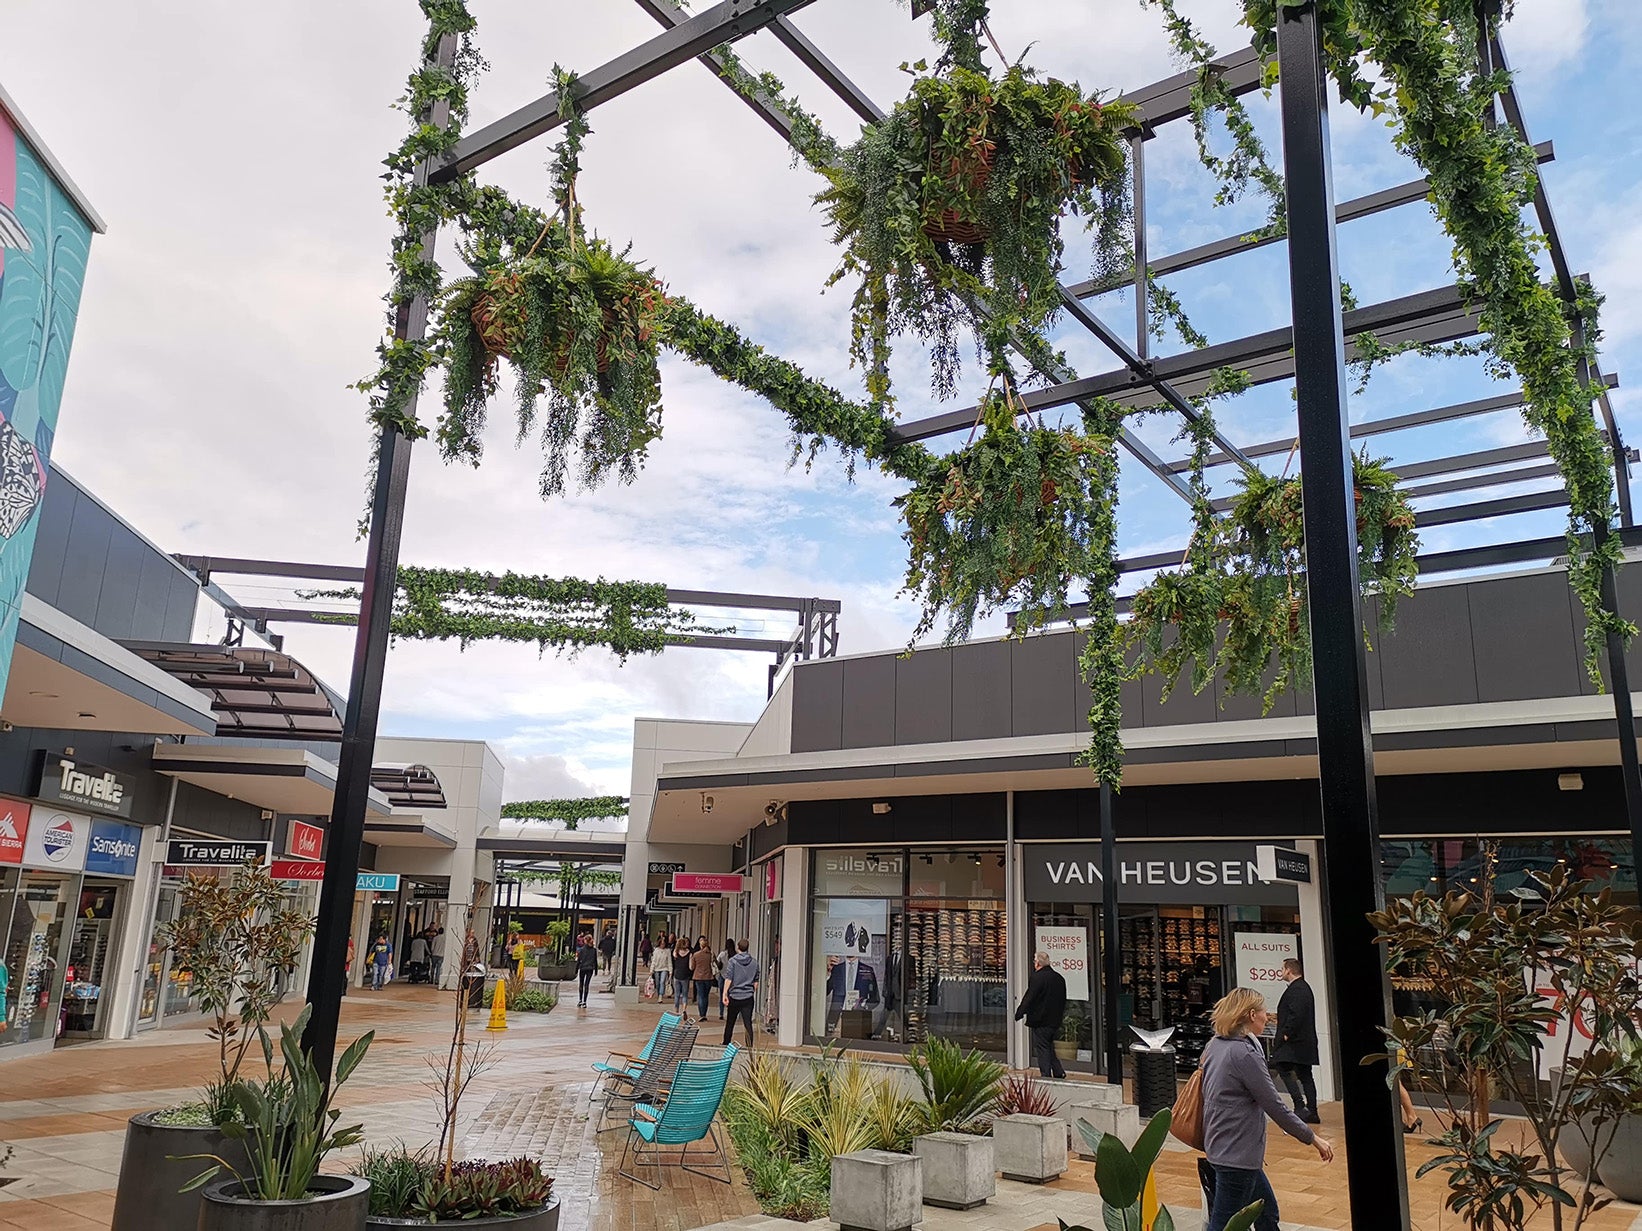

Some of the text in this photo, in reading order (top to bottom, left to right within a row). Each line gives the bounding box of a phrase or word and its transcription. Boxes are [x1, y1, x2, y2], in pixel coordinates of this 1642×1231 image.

[45, 829, 73, 840] AMERICAN
[1, 839, 22, 848] SIERRA
[44, 836, 72, 846] TOURISTER
[92, 836, 136, 857] Samsonite
[1277, 858, 1309, 873] VAN HEUSEN
[1046, 861, 1271, 885] VAN HEUSEN
[1041, 935, 1082, 943] BUSINESS
[1241, 943, 1291, 952] ALL SUITS
[1062, 958, 1084, 970] $89
[1249, 967, 1283, 982] $299
